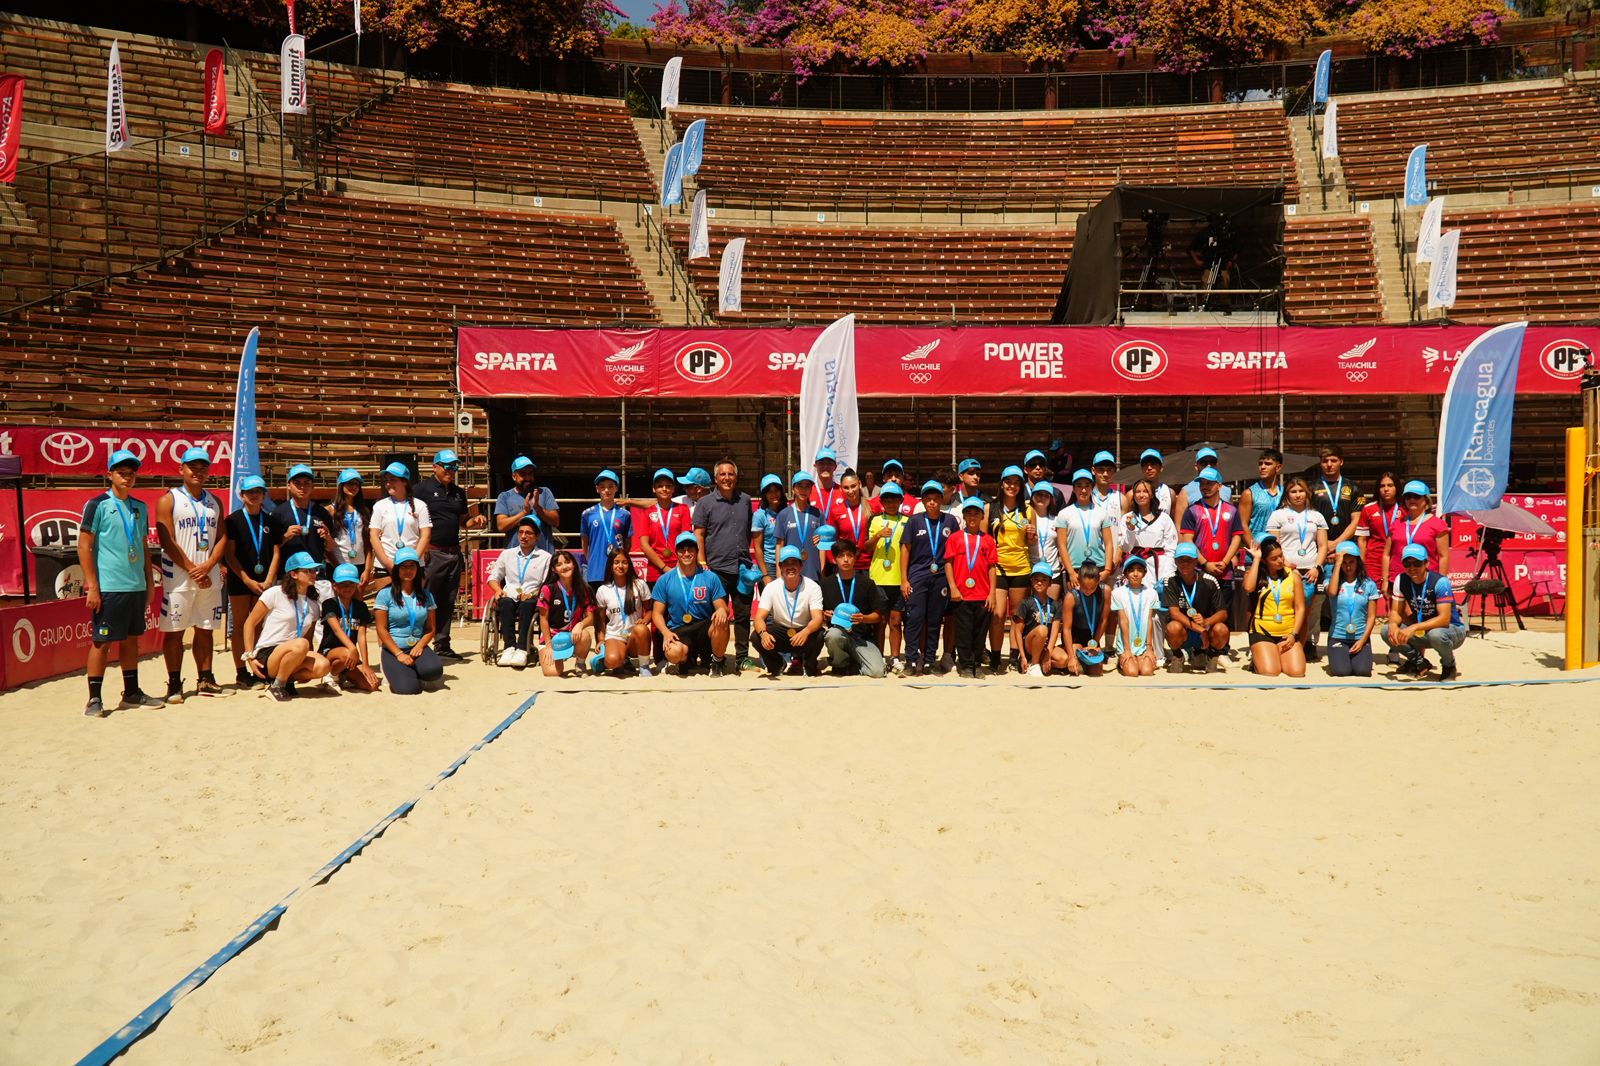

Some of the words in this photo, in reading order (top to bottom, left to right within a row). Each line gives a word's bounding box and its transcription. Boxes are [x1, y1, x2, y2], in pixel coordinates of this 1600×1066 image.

[288, 47, 300, 107] Summit
[473, 351, 557, 371] SPARTA
[690, 350, 717, 374] PF
[768, 352, 807, 371] SPA
[984, 342, 1063, 360] POWER
[1126, 348, 1153, 373] PF
[1206, 351, 1288, 370] SPARTA
[1553, 347, 1582, 372] PF
[1463, 361, 1496, 461] Rancagua
[100, 437, 233, 464] TOYOTA
[1484, 419, 1496, 461] Deportes
[39, 520, 79, 546] PF
[693, 586, 707, 600] U
[212, 606, 223, 621] 15
[39, 624, 73, 647] GRUPO
